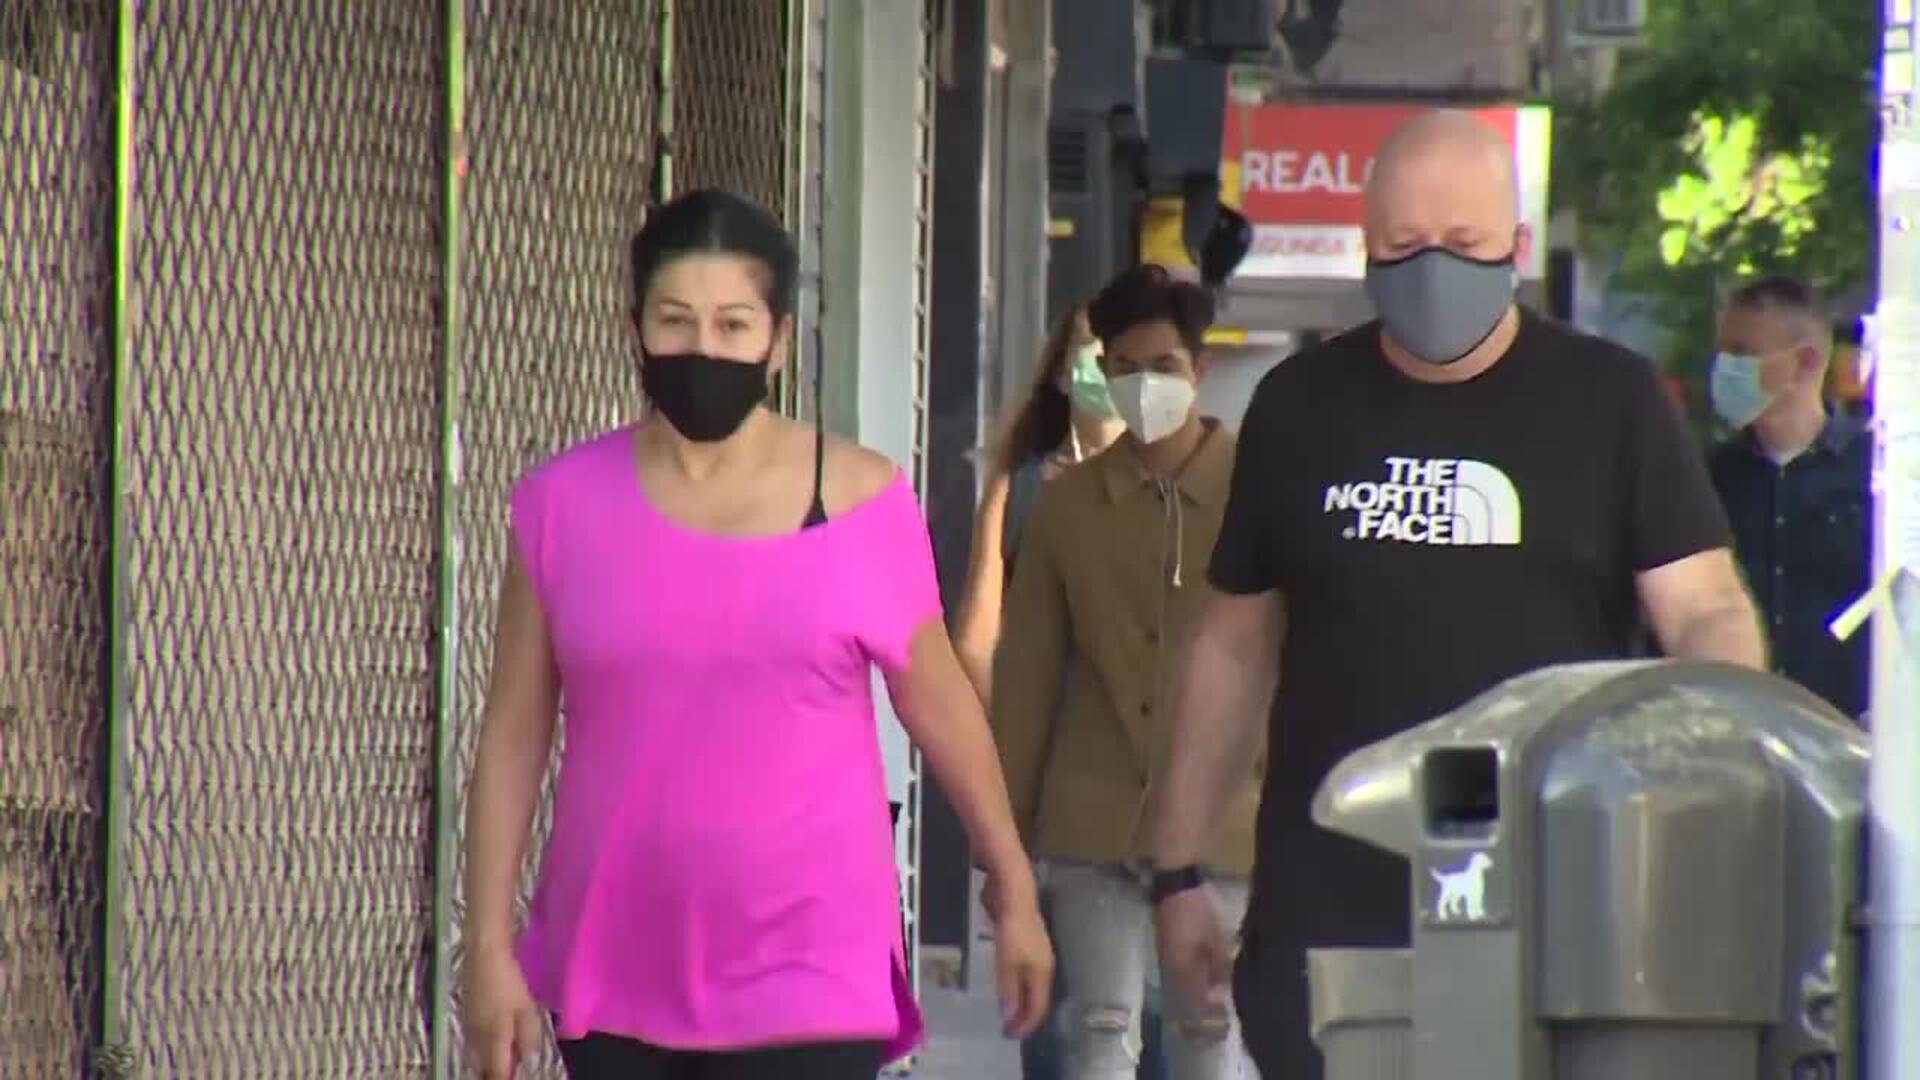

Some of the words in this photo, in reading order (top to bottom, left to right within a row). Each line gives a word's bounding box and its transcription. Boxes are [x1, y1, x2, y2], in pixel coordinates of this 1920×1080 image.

[1242, 151, 1374, 193] REAL
[1385, 456, 1456, 485] THE
[1324, 482, 1452, 513] NORTH
[1358, 511, 1451, 544] FACE
